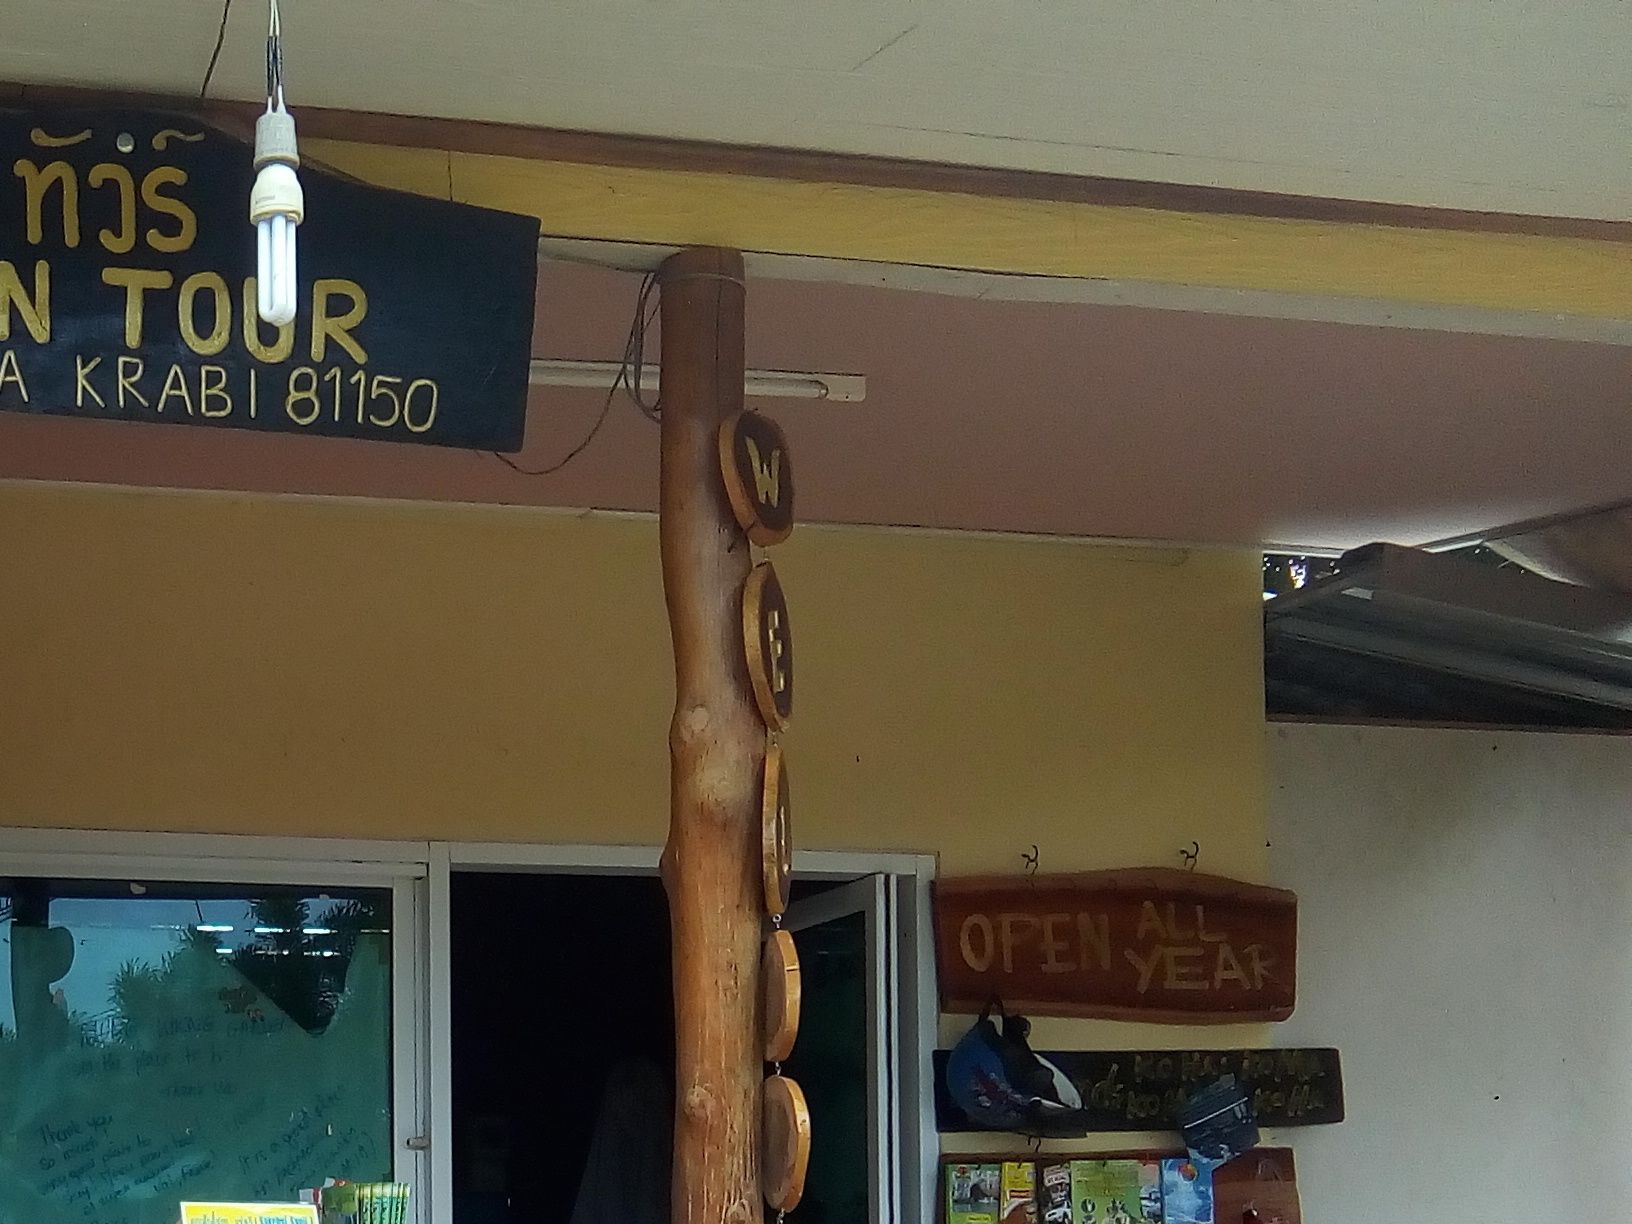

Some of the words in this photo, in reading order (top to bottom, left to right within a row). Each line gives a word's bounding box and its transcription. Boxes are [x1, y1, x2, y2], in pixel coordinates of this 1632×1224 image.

[13, 126, 206, 256] ทัวร์
[100, 267, 369, 365] TOUR
[76, 354, 258, 421] KRABI
[284, 366, 439, 434] 81150
[744, 435, 782, 508] W
[959, 912, 1112, 974] OPEN
[1136, 899, 1228, 943] ALL
